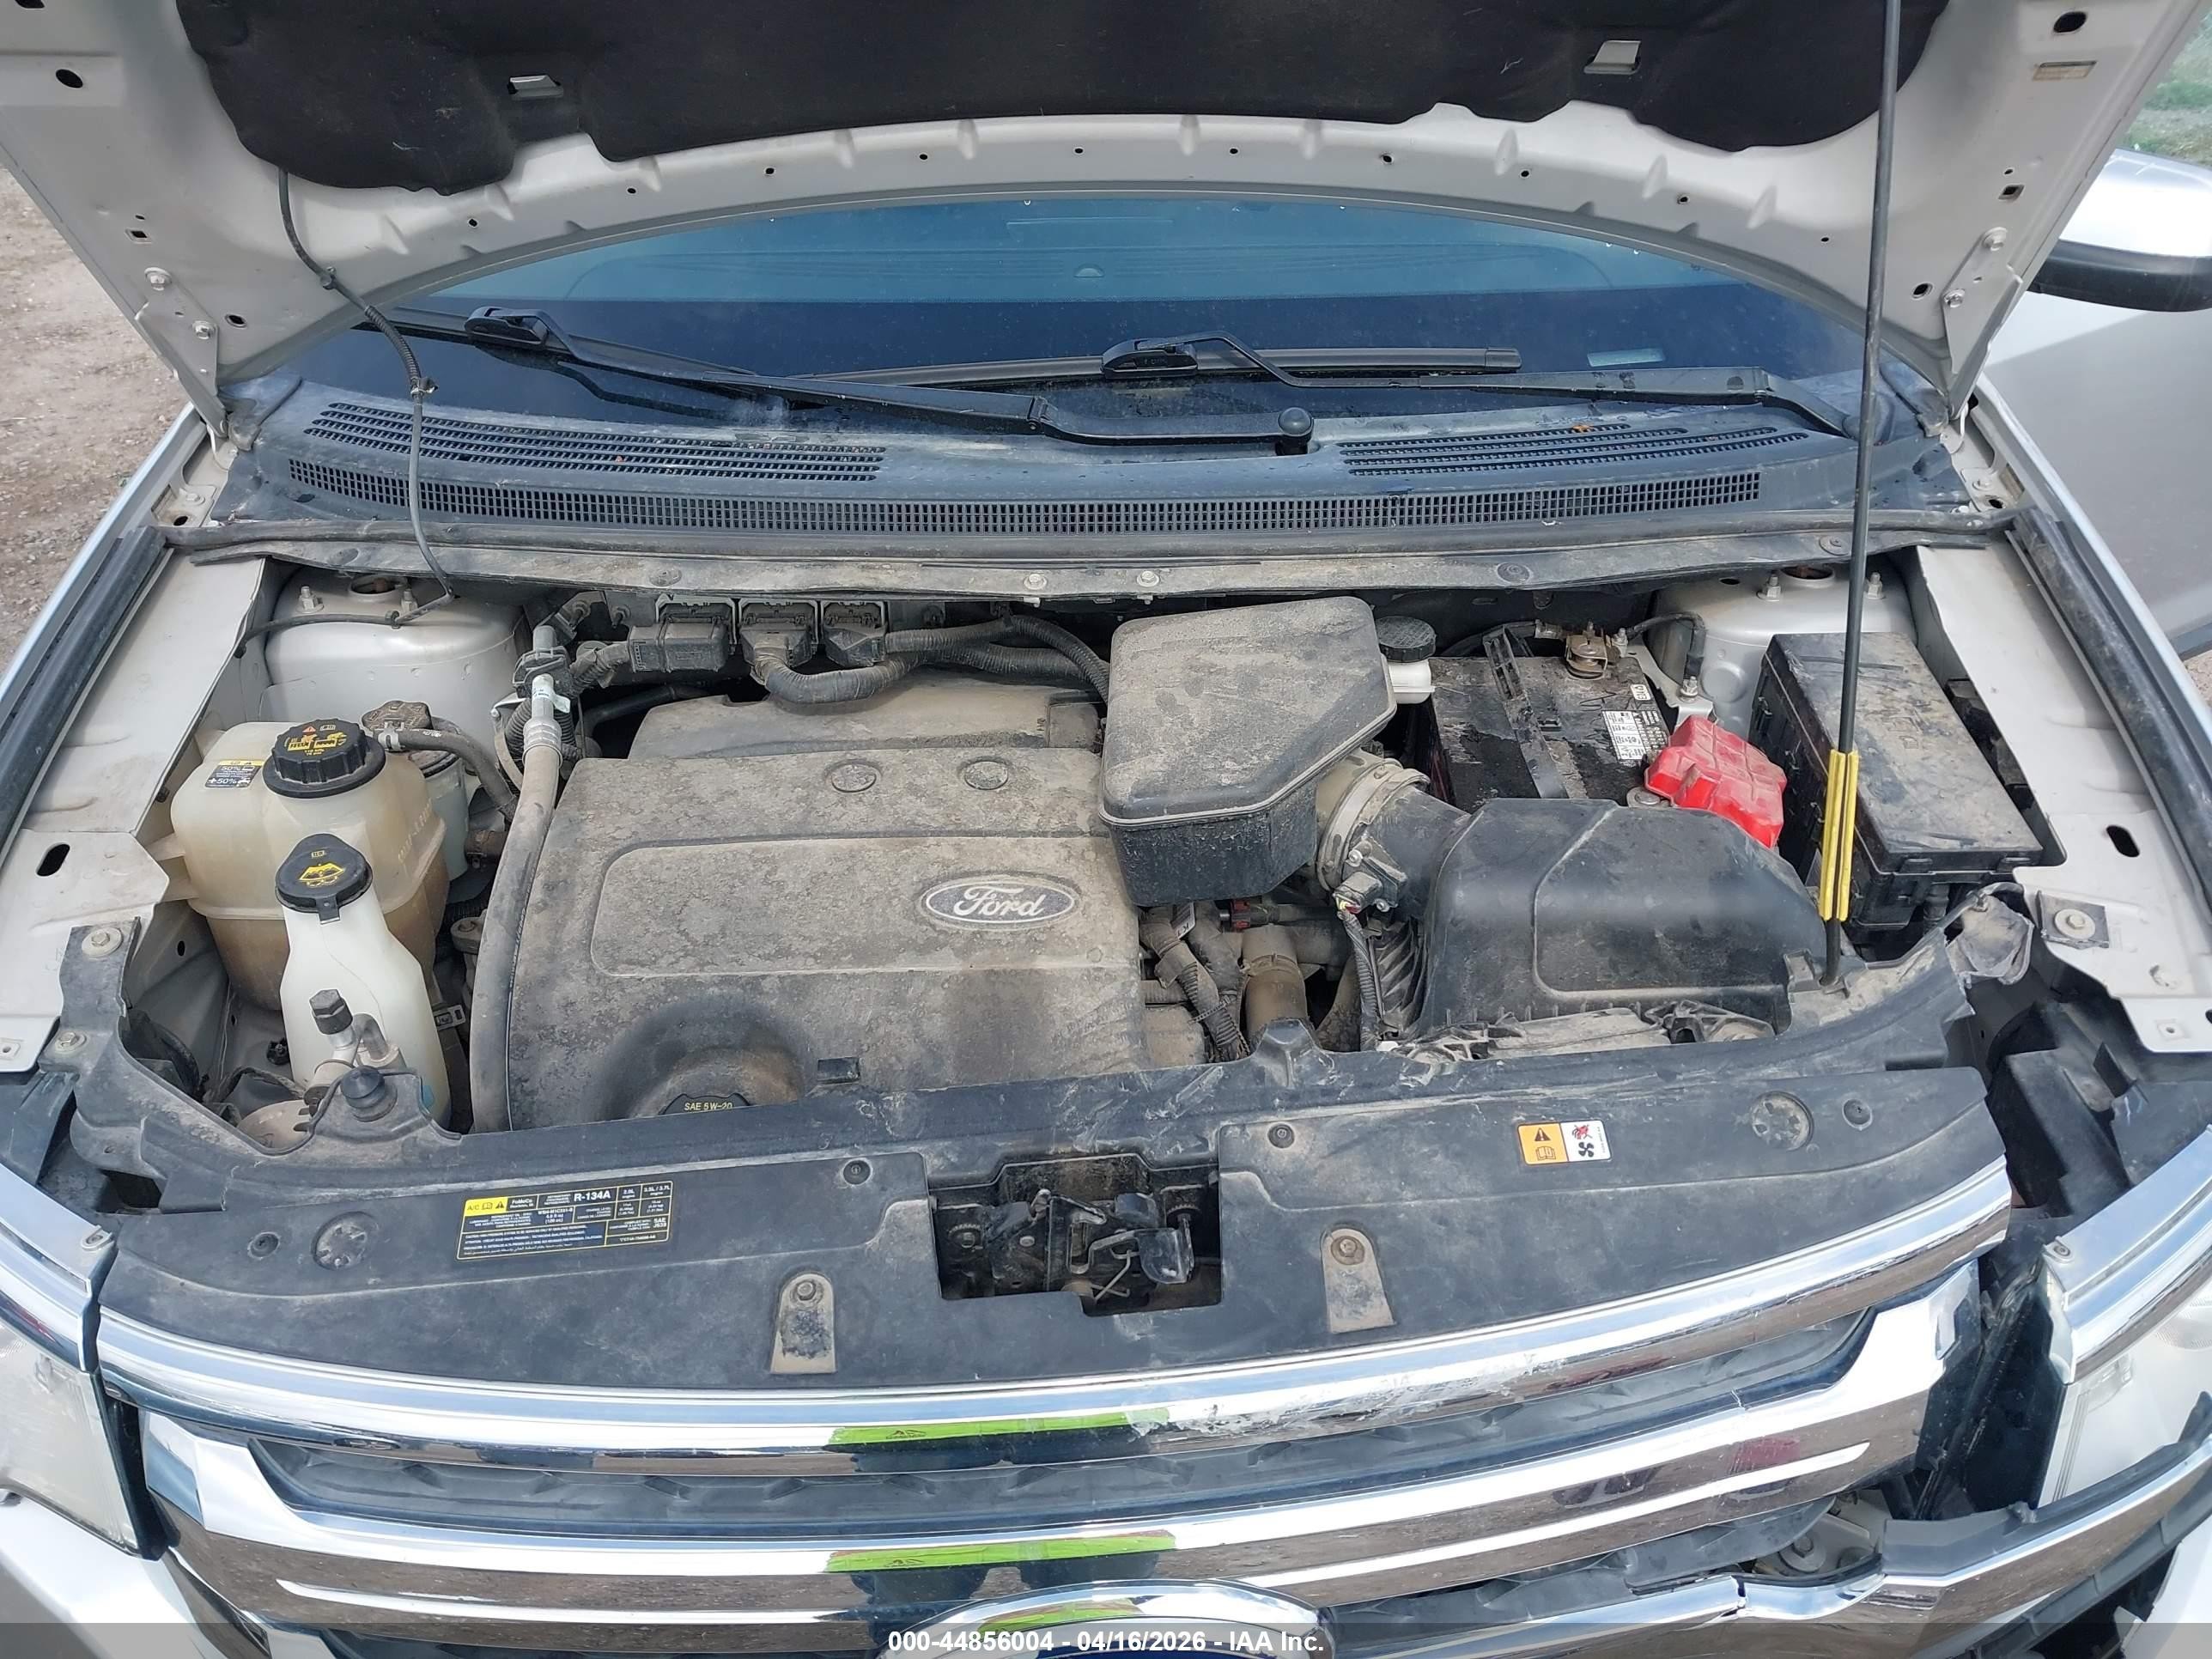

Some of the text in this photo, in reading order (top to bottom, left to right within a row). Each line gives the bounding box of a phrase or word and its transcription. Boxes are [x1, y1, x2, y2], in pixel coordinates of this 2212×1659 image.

[953, 885, 1047, 917] Ford
[684, 1102, 702, 1111] SAE
[574, 1189, 611, 1202] R-134A
